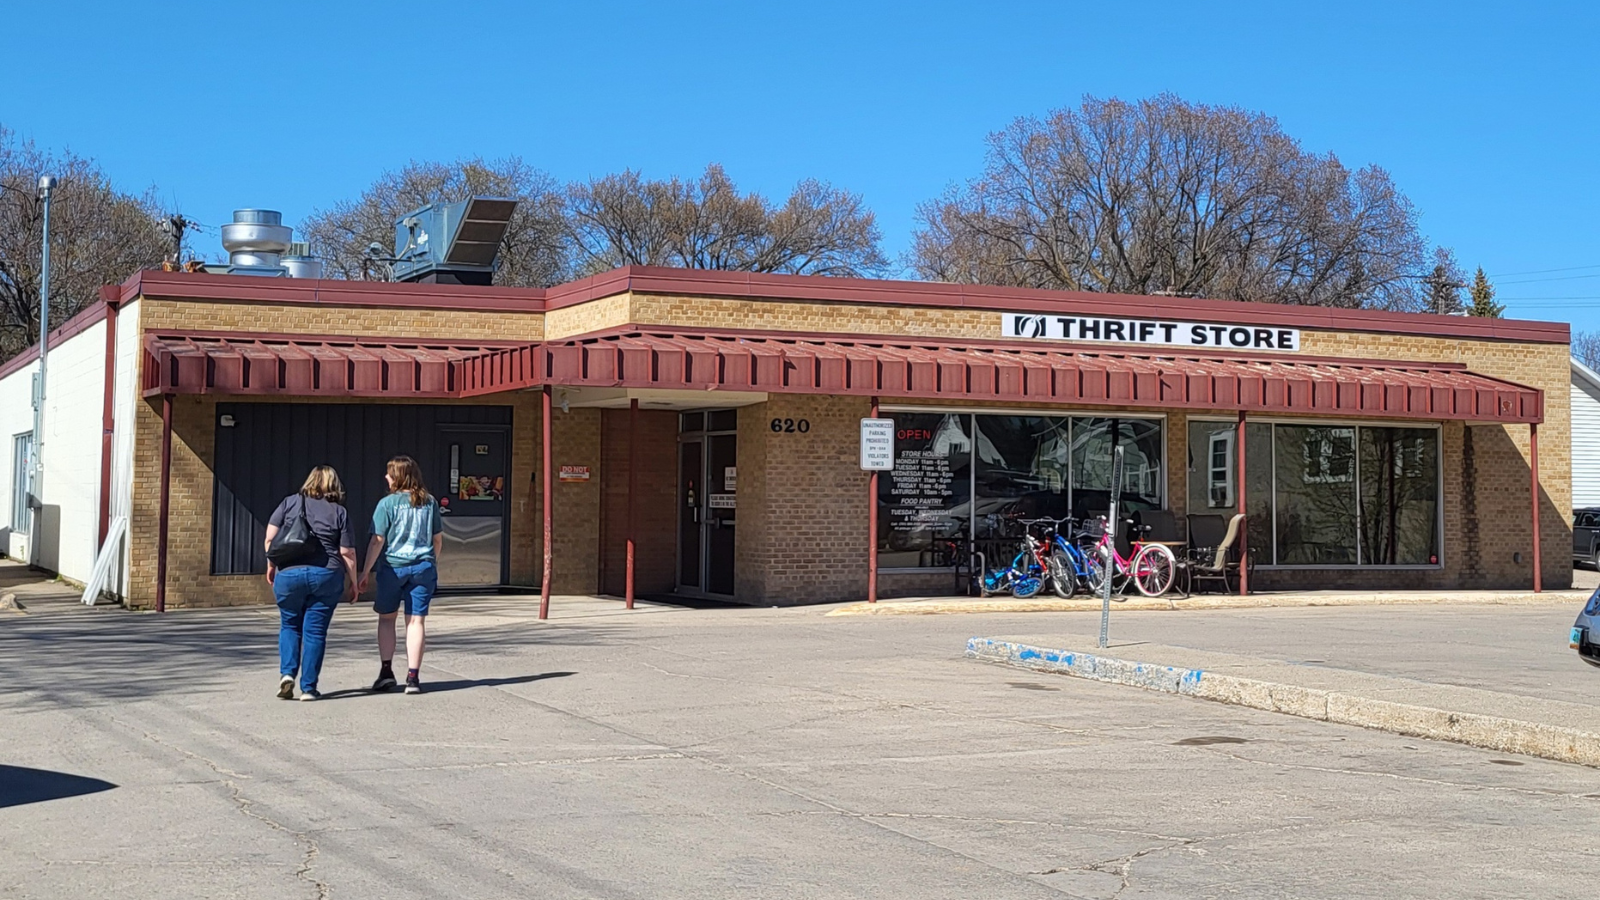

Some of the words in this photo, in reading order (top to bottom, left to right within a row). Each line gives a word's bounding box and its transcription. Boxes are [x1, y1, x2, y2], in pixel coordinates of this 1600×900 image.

[1057, 317, 1178, 343] THRIFT
[1190, 325, 1294, 349] STORE
[771, 418, 810, 433] 620
[897, 429, 931, 440] OPEN
